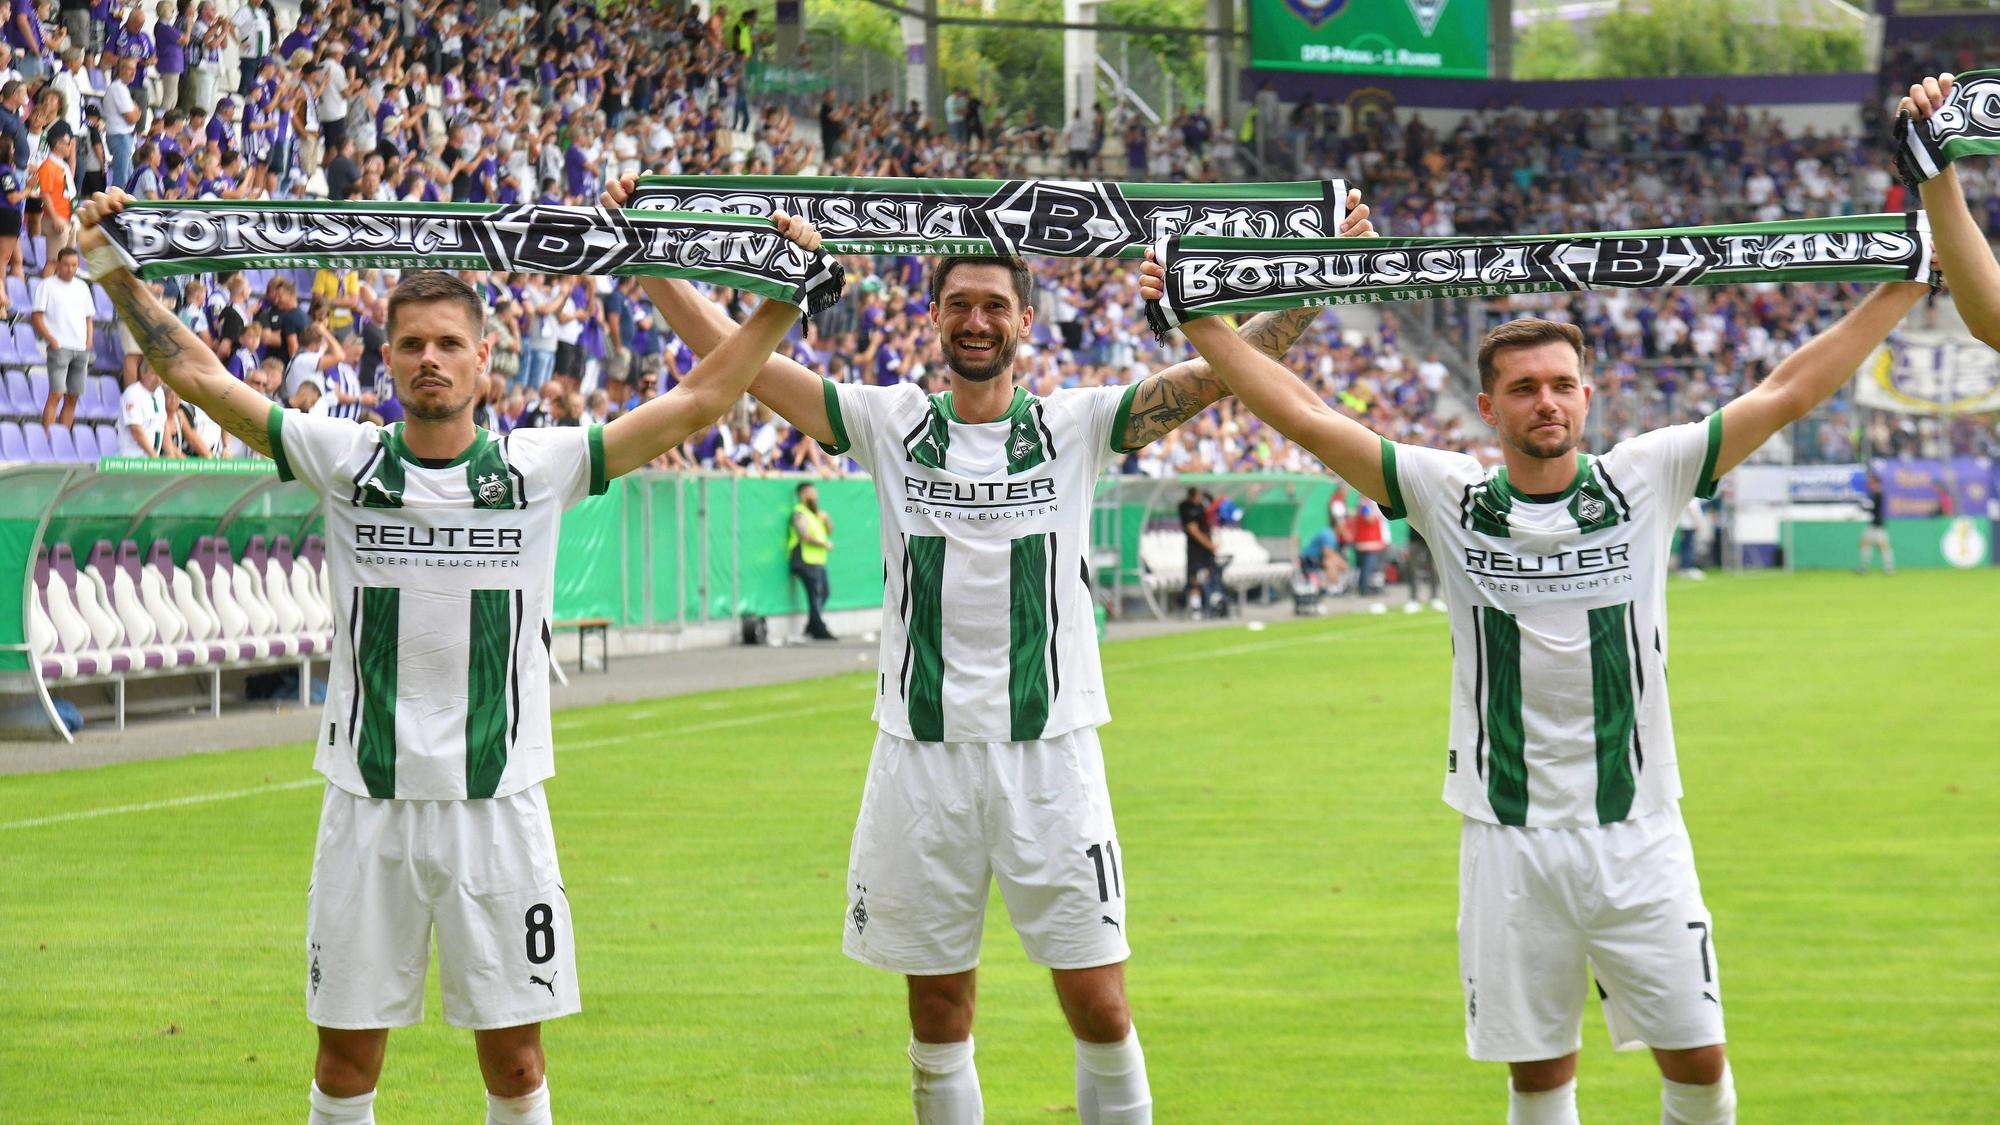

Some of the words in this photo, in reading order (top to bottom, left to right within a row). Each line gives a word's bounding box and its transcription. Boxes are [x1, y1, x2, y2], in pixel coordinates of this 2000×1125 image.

[116, 208, 462, 255] BORUSSIA
[1144, 205, 1327, 243] FANS
[836, 243, 875, 254] UND
[1170, 244, 1531, 302] BORUSSIA
[1717, 231, 1916, 270] FANS
[1302, 292, 1384, 308] IMMER
[1391, 288, 1434, 301] UND
[905, 476, 1056, 501] REUTER
[967, 504, 1059, 521] LEUCHTEN
[355, 524, 522, 548] REUTER
[425, 559, 520, 568] LEUCHTEN
[1464, 543, 1630, 572] REUTER
[1536, 573, 1633, 593] LEUCHTEN
[1086, 840, 1121, 903] 11
[525, 903, 555, 964] 8
[1687, 921, 1712, 983] 7
